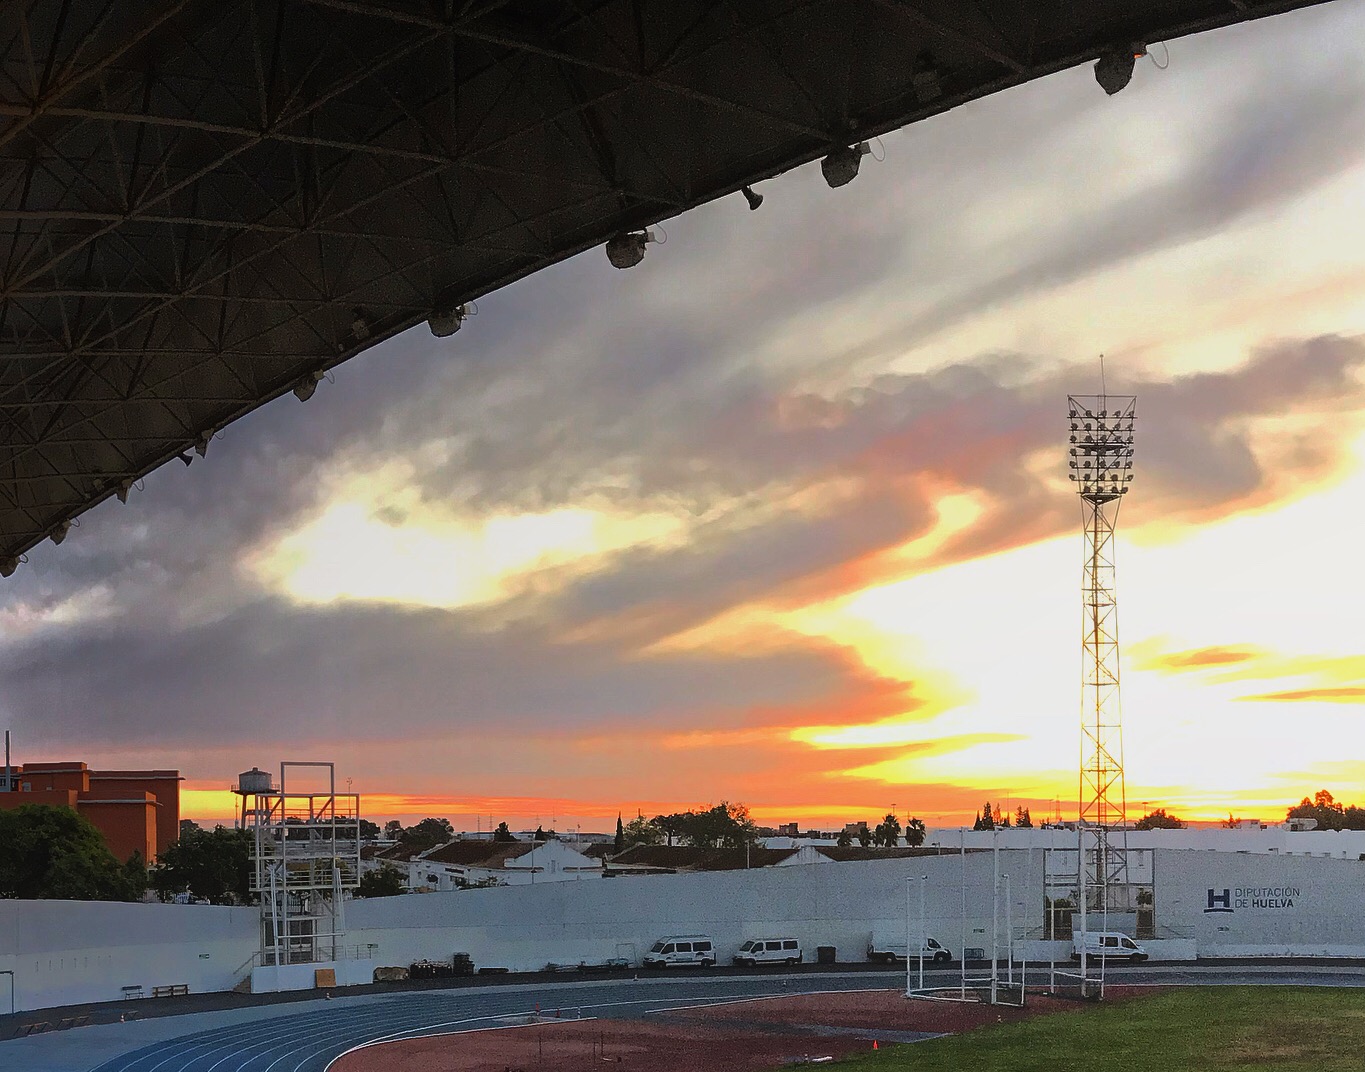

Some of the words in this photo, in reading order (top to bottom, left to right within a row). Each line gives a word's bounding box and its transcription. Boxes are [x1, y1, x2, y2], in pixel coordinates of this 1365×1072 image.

[1235, 887, 1300, 897] DIPUTACIÓN
[1208, 889, 1230, 908] H
[1235, 899, 1250, 908] DE
[1252, 899, 1294, 908] HUELVA
